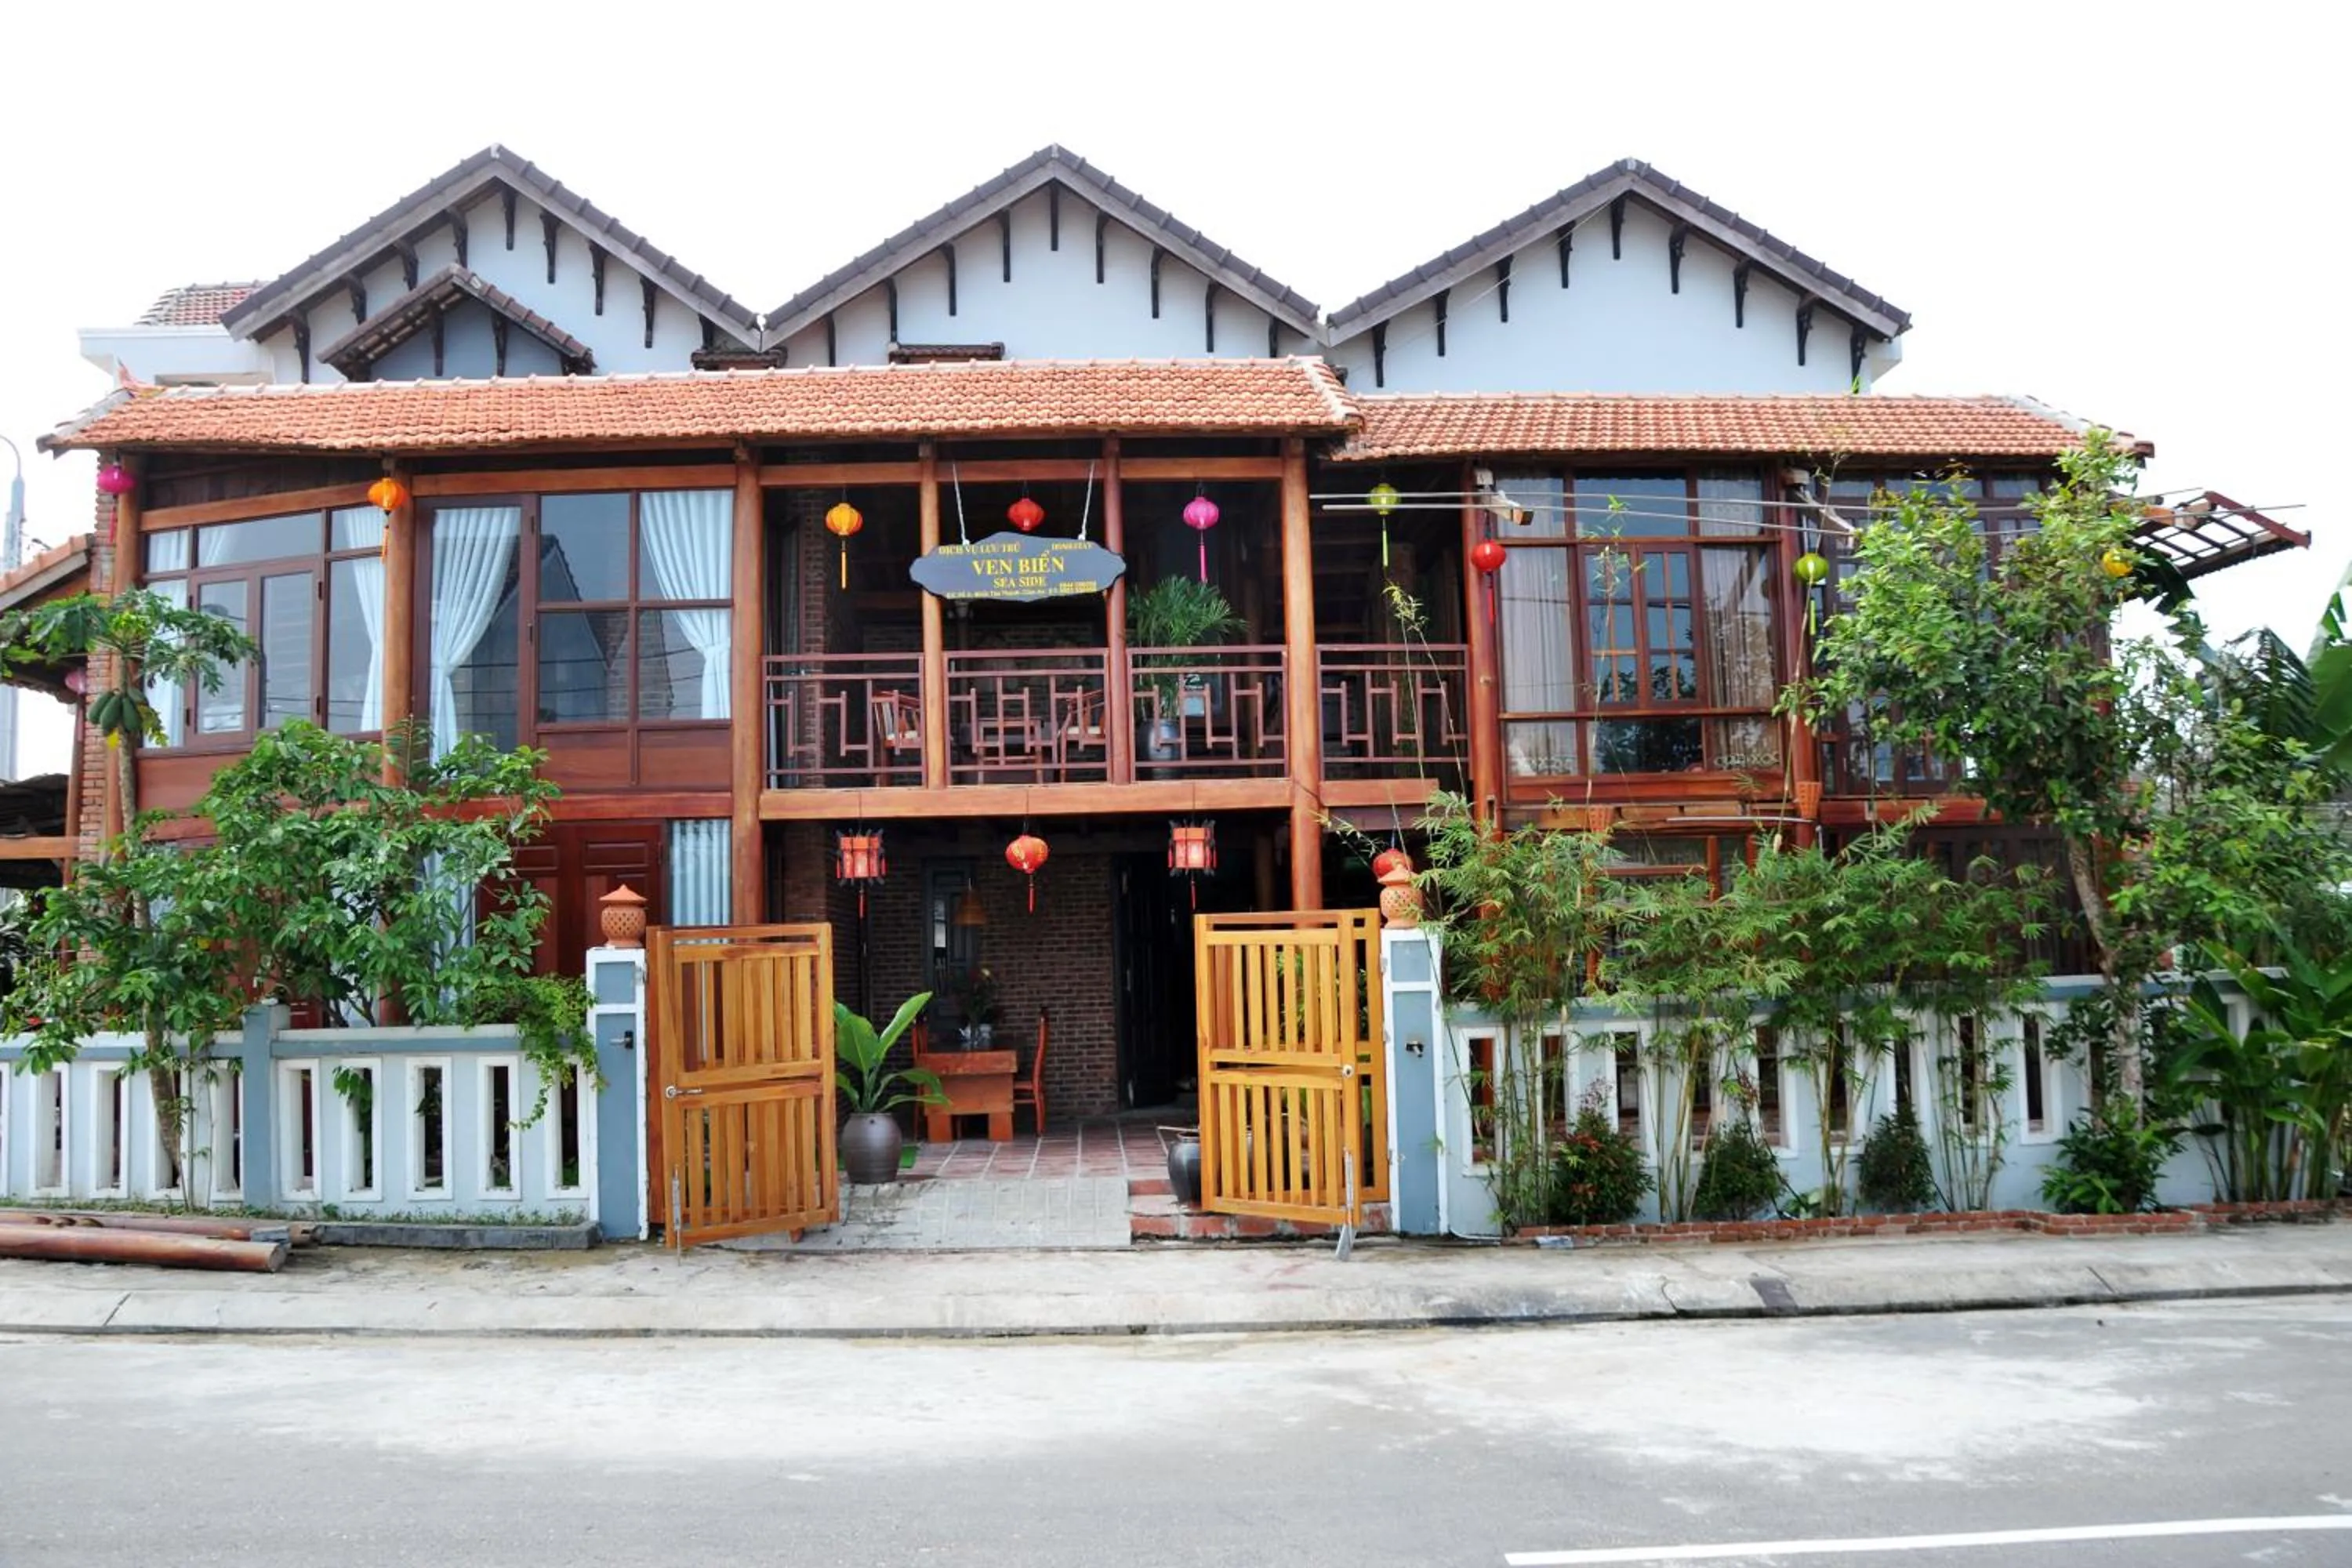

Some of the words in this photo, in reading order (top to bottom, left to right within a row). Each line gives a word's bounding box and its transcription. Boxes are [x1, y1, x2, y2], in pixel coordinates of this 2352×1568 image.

[972, 559, 1013, 575] VEN
[1018, 550, 1064, 574] BIỂN
[993, 577, 1016, 589] SEA
[1019, 576, 1047, 588] SIDE
